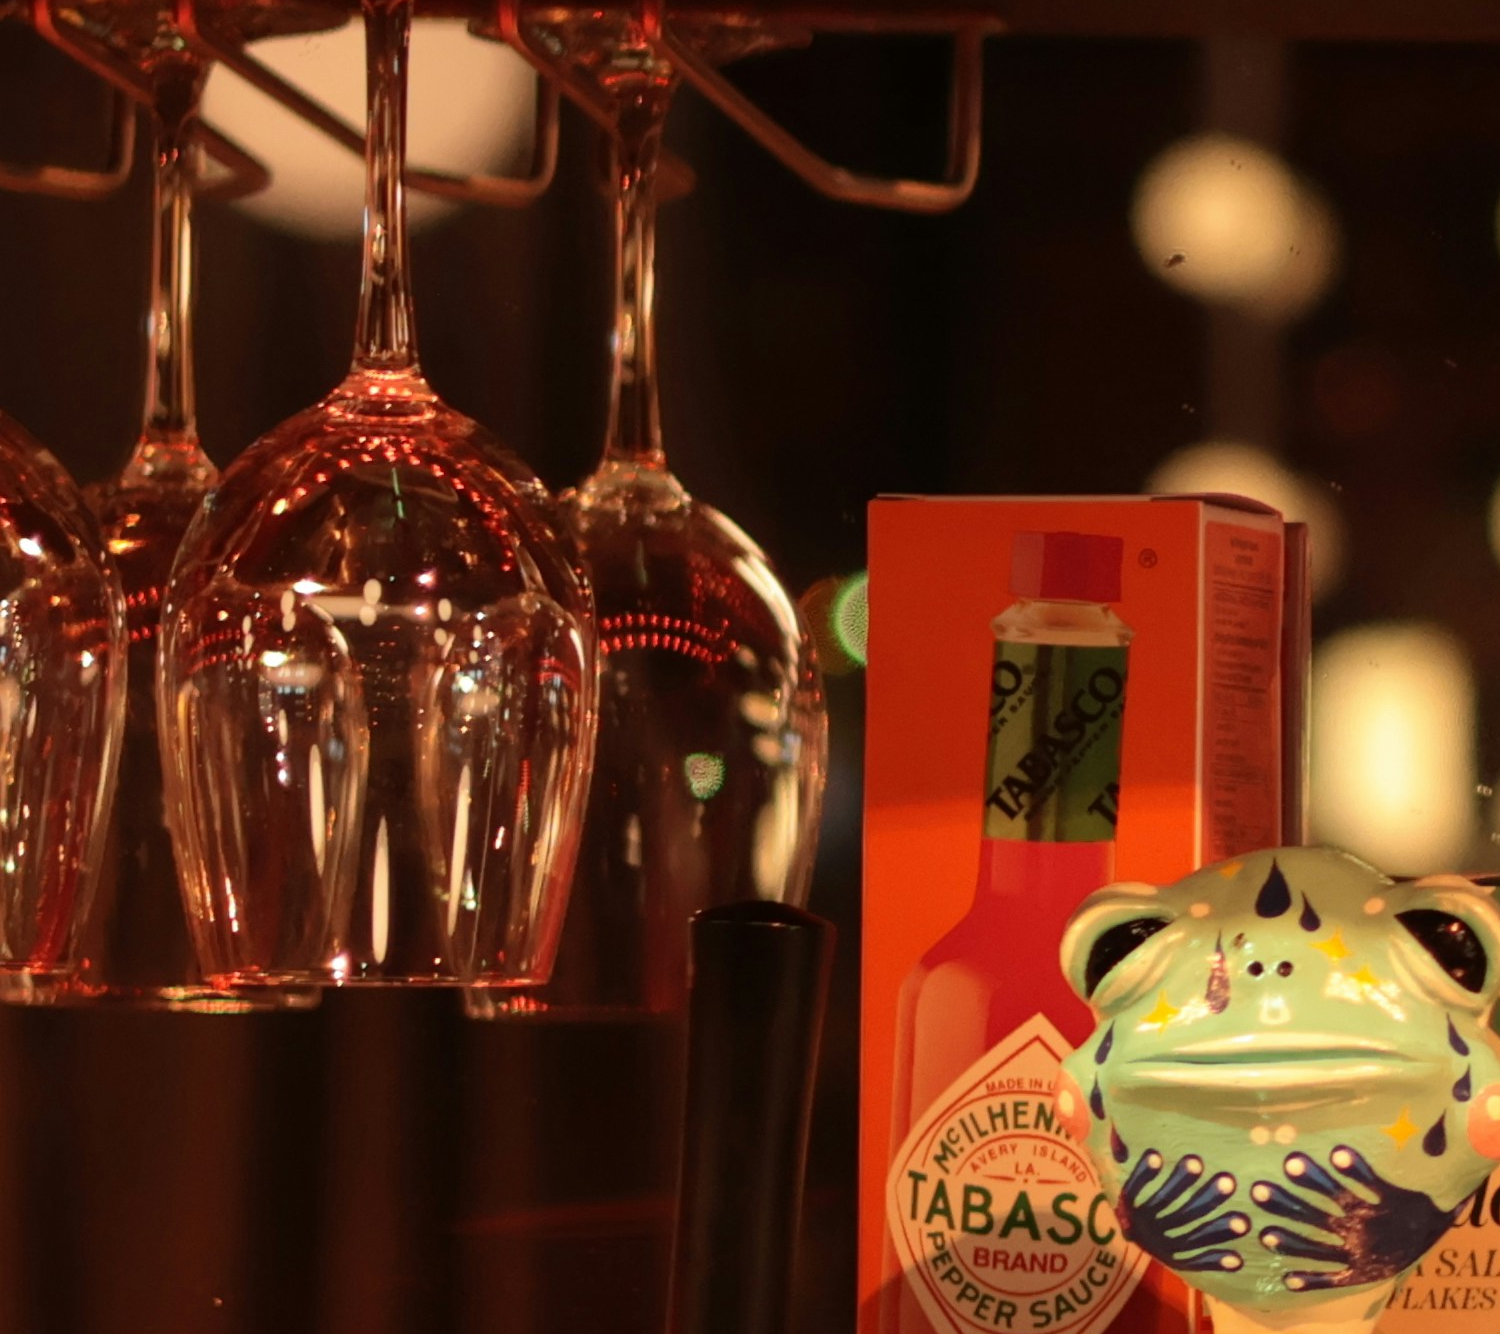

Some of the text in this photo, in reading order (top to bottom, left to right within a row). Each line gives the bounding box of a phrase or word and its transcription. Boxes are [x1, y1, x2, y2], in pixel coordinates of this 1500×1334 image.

[986, 667, 1124, 821] TABASCO
[985, 1078, 1024, 1094] MADE
[1029, 1078, 1043, 1091] IN
[933, 1101, 1073, 1175] McILHEN
[969, 1142, 1088, 1184] AVERY ISLAND
[907, 1169, 1117, 1247] TABASC
[926, 1230, 1117, 1329] PEPPER SAUCE
[972, 1246, 1069, 1275] BRAND
